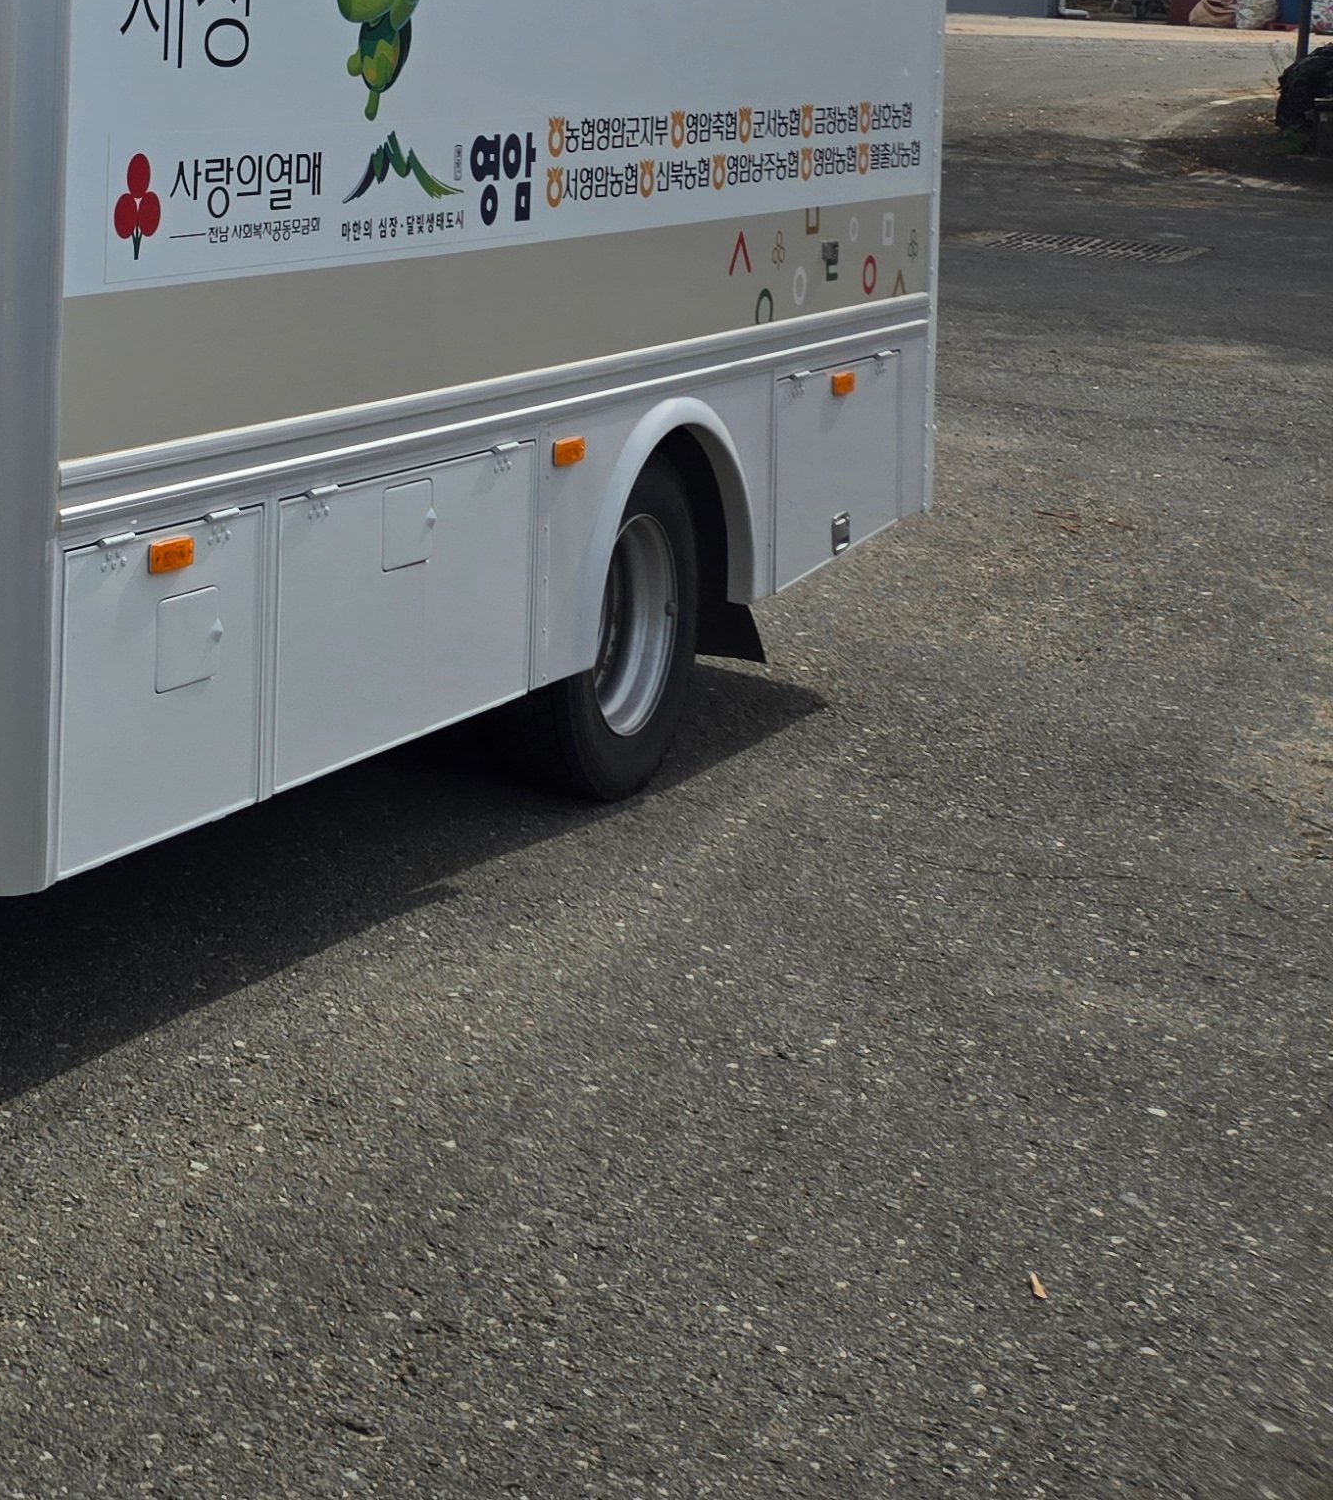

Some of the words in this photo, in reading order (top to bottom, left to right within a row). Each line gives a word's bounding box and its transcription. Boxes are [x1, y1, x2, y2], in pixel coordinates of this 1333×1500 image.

[564, 115, 668, 154] 농협영암군지부
[685, 110, 737, 145] 영암축협
[753, 107, 800, 139] 군서농협
[814, 104, 858, 135] 금정농협
[871, 102, 912, 130] 삼호농협
[169, 151, 323, 219] 사랑의열매
[470, 131, 537, 227] 영암
[562, 162, 638, 201] 서영암농협
[656, 157, 710, 192] 신북농협
[813, 145, 857, 176] 영암농협
[208, 225, 230, 244] 전남
[341, 218, 373, 242] 마한의
